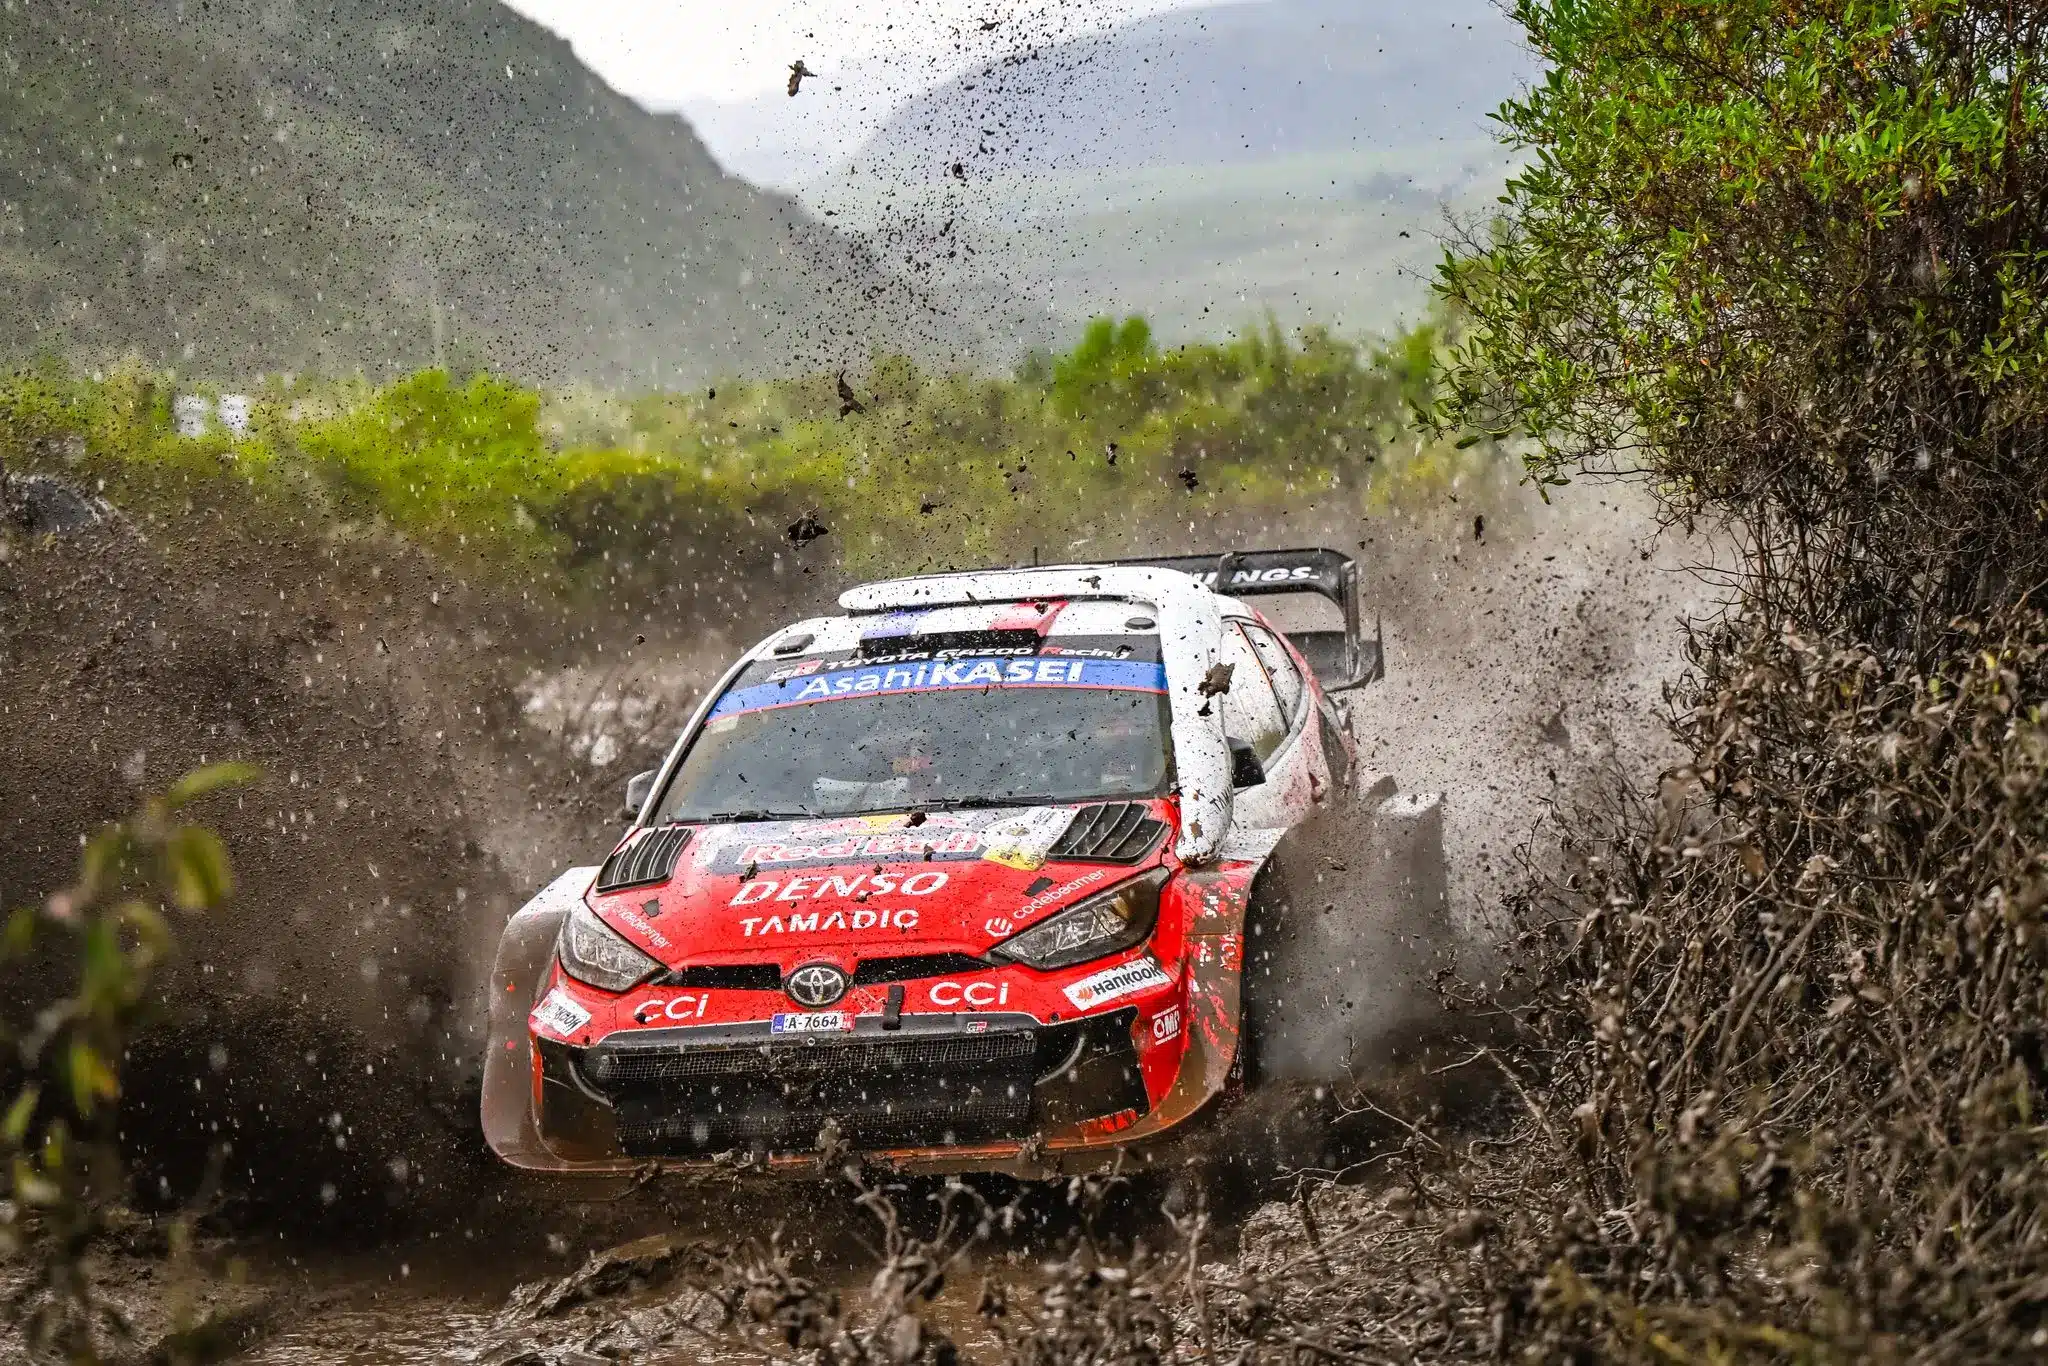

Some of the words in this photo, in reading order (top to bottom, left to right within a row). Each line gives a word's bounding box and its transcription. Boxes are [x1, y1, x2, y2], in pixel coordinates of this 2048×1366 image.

[827, 652, 928, 669] TOYOTA
[935, 647, 1034, 661] GAZOO
[736, 837, 866, 865] Red
[729, 872, 949, 906] DENSO
[1013, 869, 1105, 919] codebeamer
[740, 909, 919, 937] TAMADIC
[788, 1015, 838, 1029] A-7664
